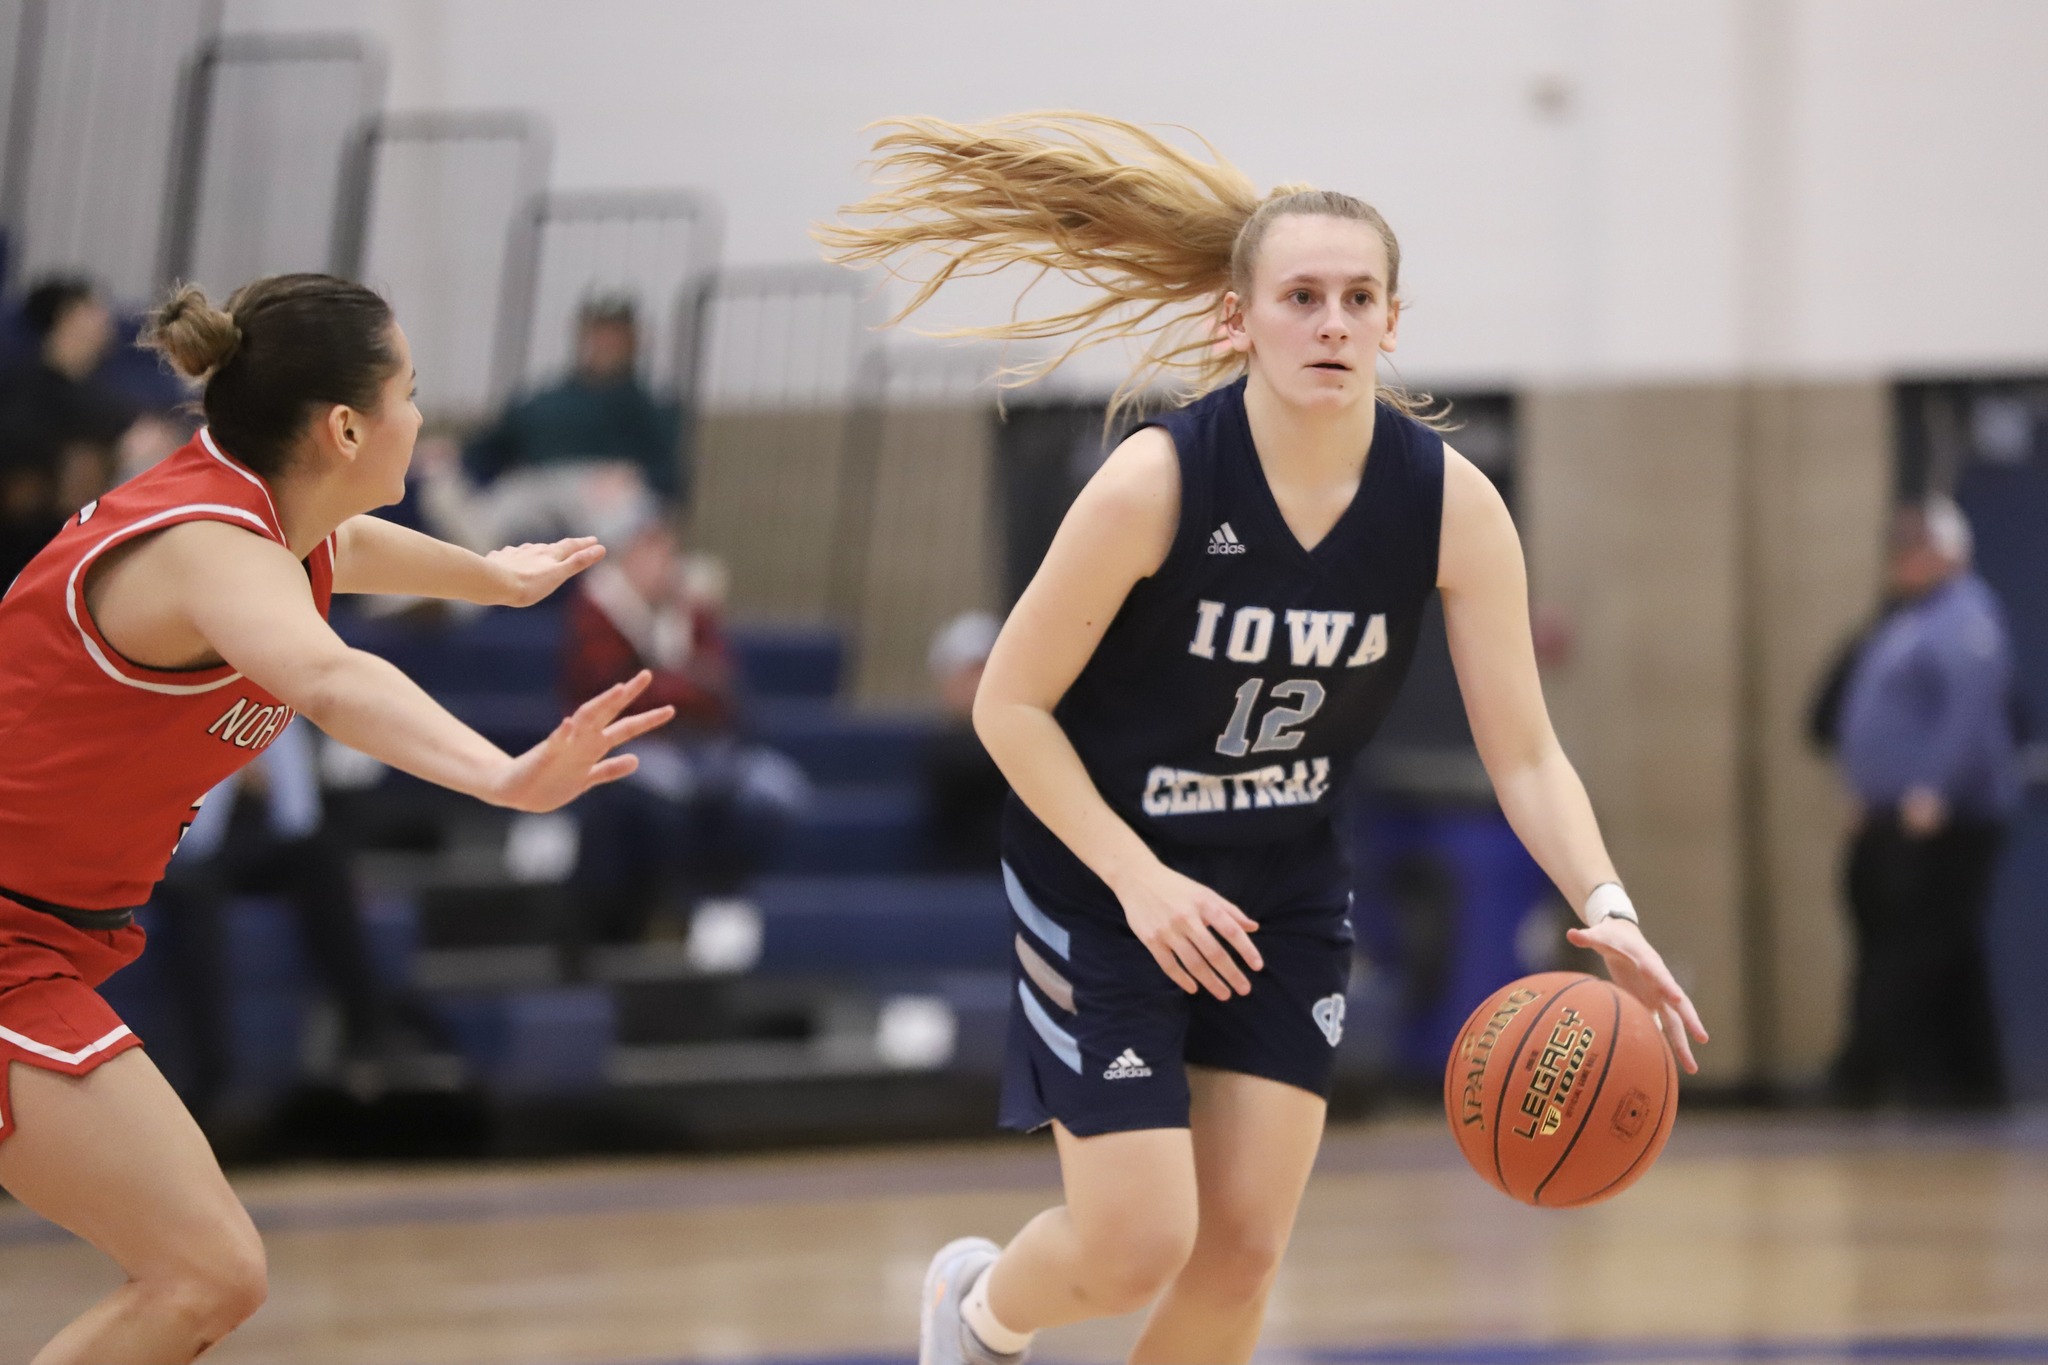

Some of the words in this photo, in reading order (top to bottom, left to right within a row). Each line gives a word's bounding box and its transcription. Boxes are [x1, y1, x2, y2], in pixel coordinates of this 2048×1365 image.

[1207, 542, 1246, 555] didas
[1187, 599, 1389, 668] IOWA
[1215, 677, 1326, 757] 12
[1142, 756, 1330, 816] CENTRAL
[1103, 1066, 1152, 1080] adidas
[1462, 987, 1542, 1130] SPALDING
[1512, 1007, 1584, 1141] LEGACY
[1541, 1106, 1560, 1134] TF
[1554, 1026, 1595, 1106] 1000
